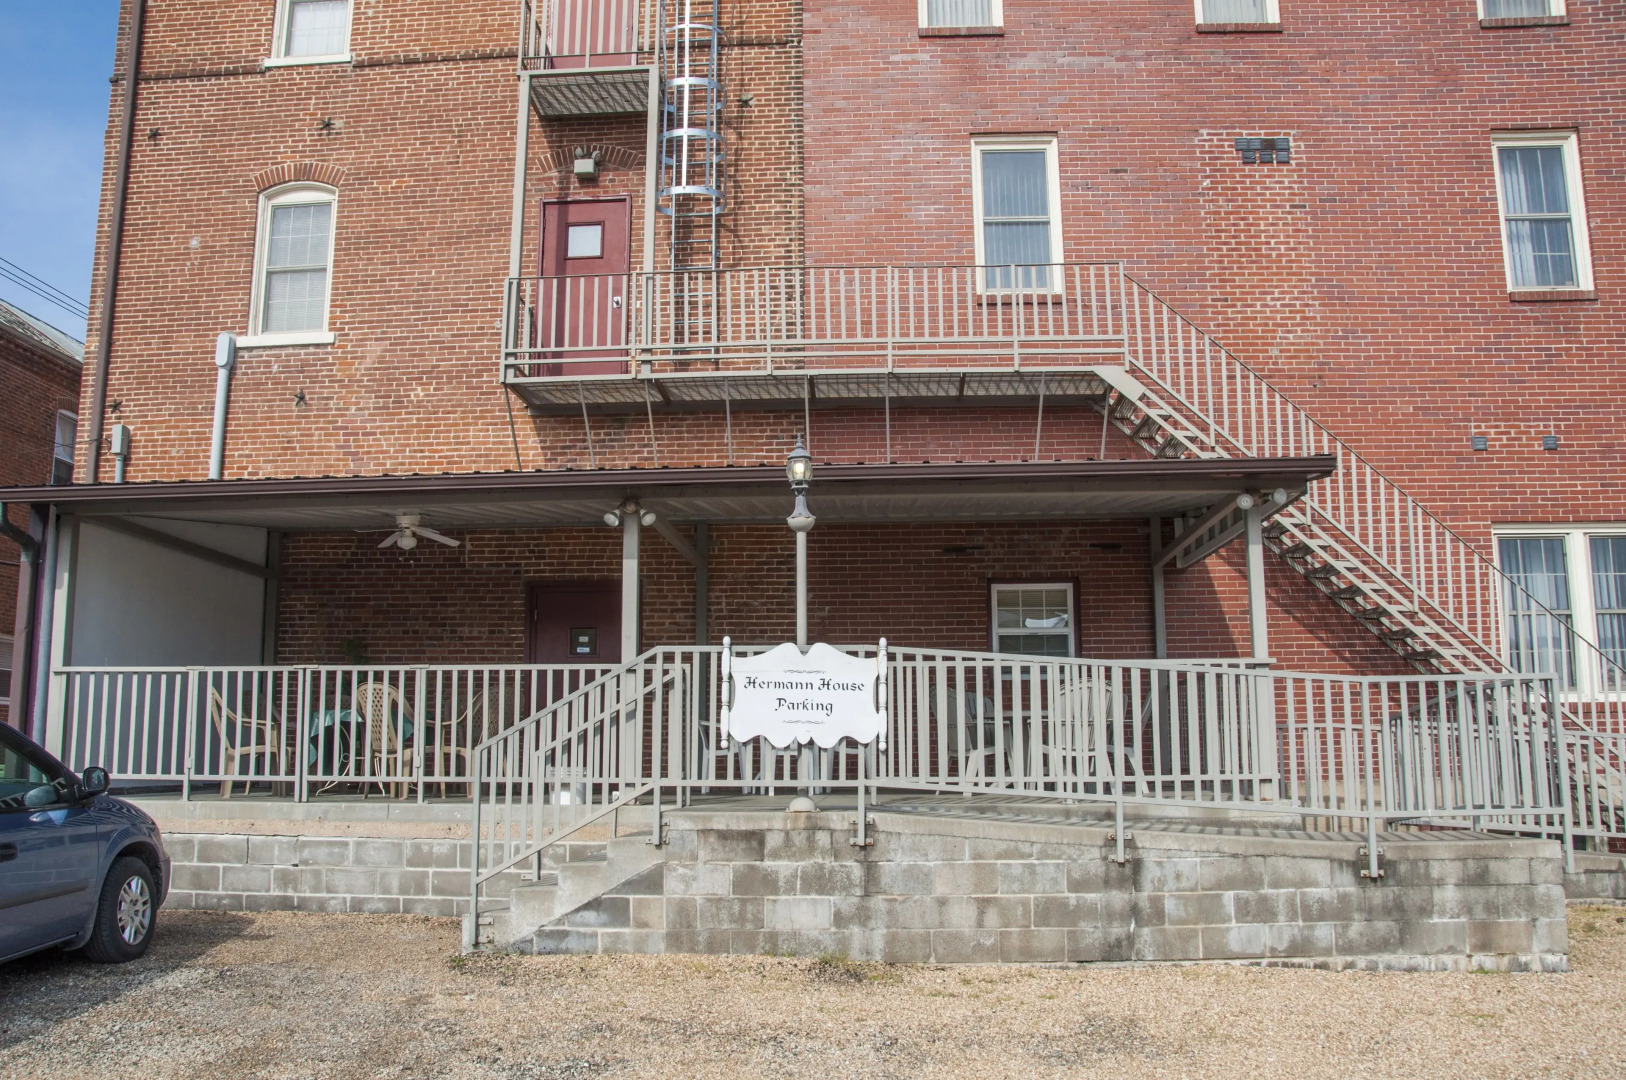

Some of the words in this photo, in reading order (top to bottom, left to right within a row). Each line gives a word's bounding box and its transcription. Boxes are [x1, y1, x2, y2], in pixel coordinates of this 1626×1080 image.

[743, 676, 814, 690] Hermann
[817, 678, 865, 692] House
[774, 697, 833, 716] Parking
